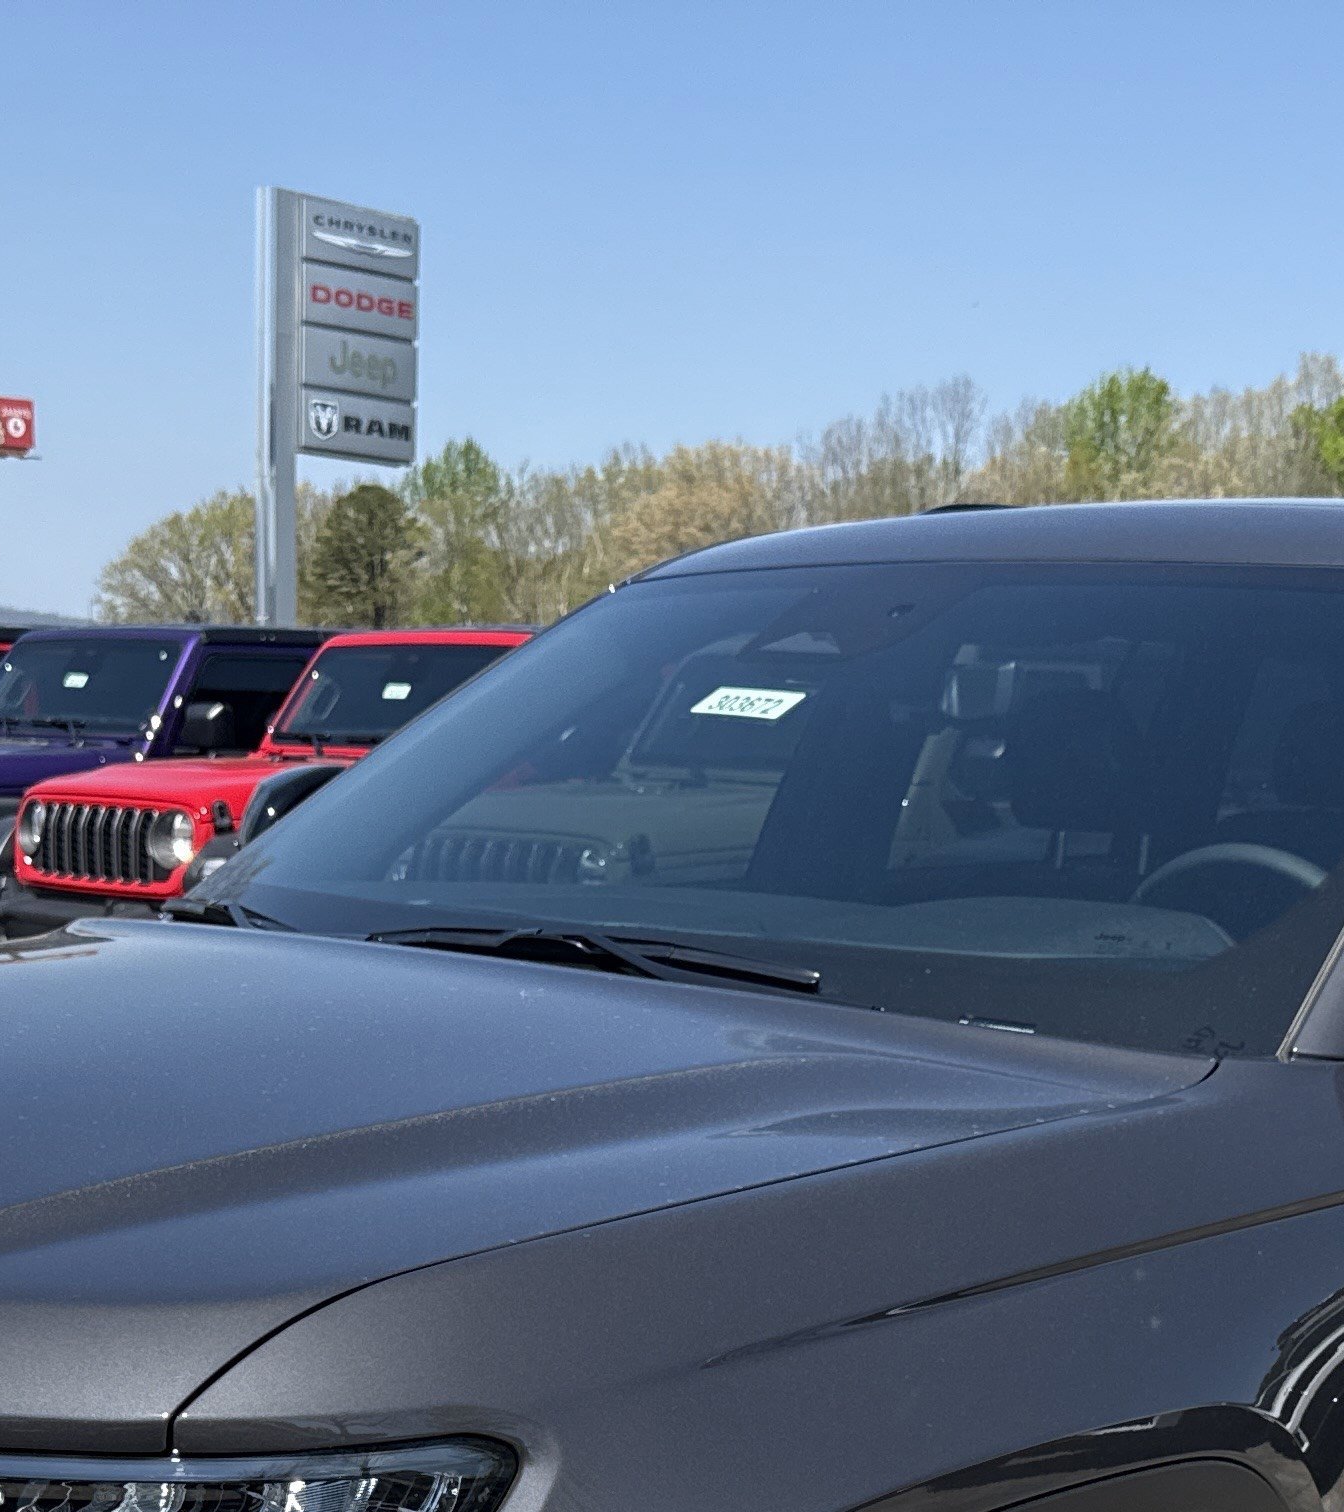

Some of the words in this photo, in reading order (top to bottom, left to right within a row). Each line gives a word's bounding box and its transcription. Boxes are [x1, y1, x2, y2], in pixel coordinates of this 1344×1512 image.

[313, 214, 413, 245] CHRYSLER
[311, 284, 415, 321] DODGE
[328, 341, 396, 388] Jeep
[343, 415, 411, 442] RAM
